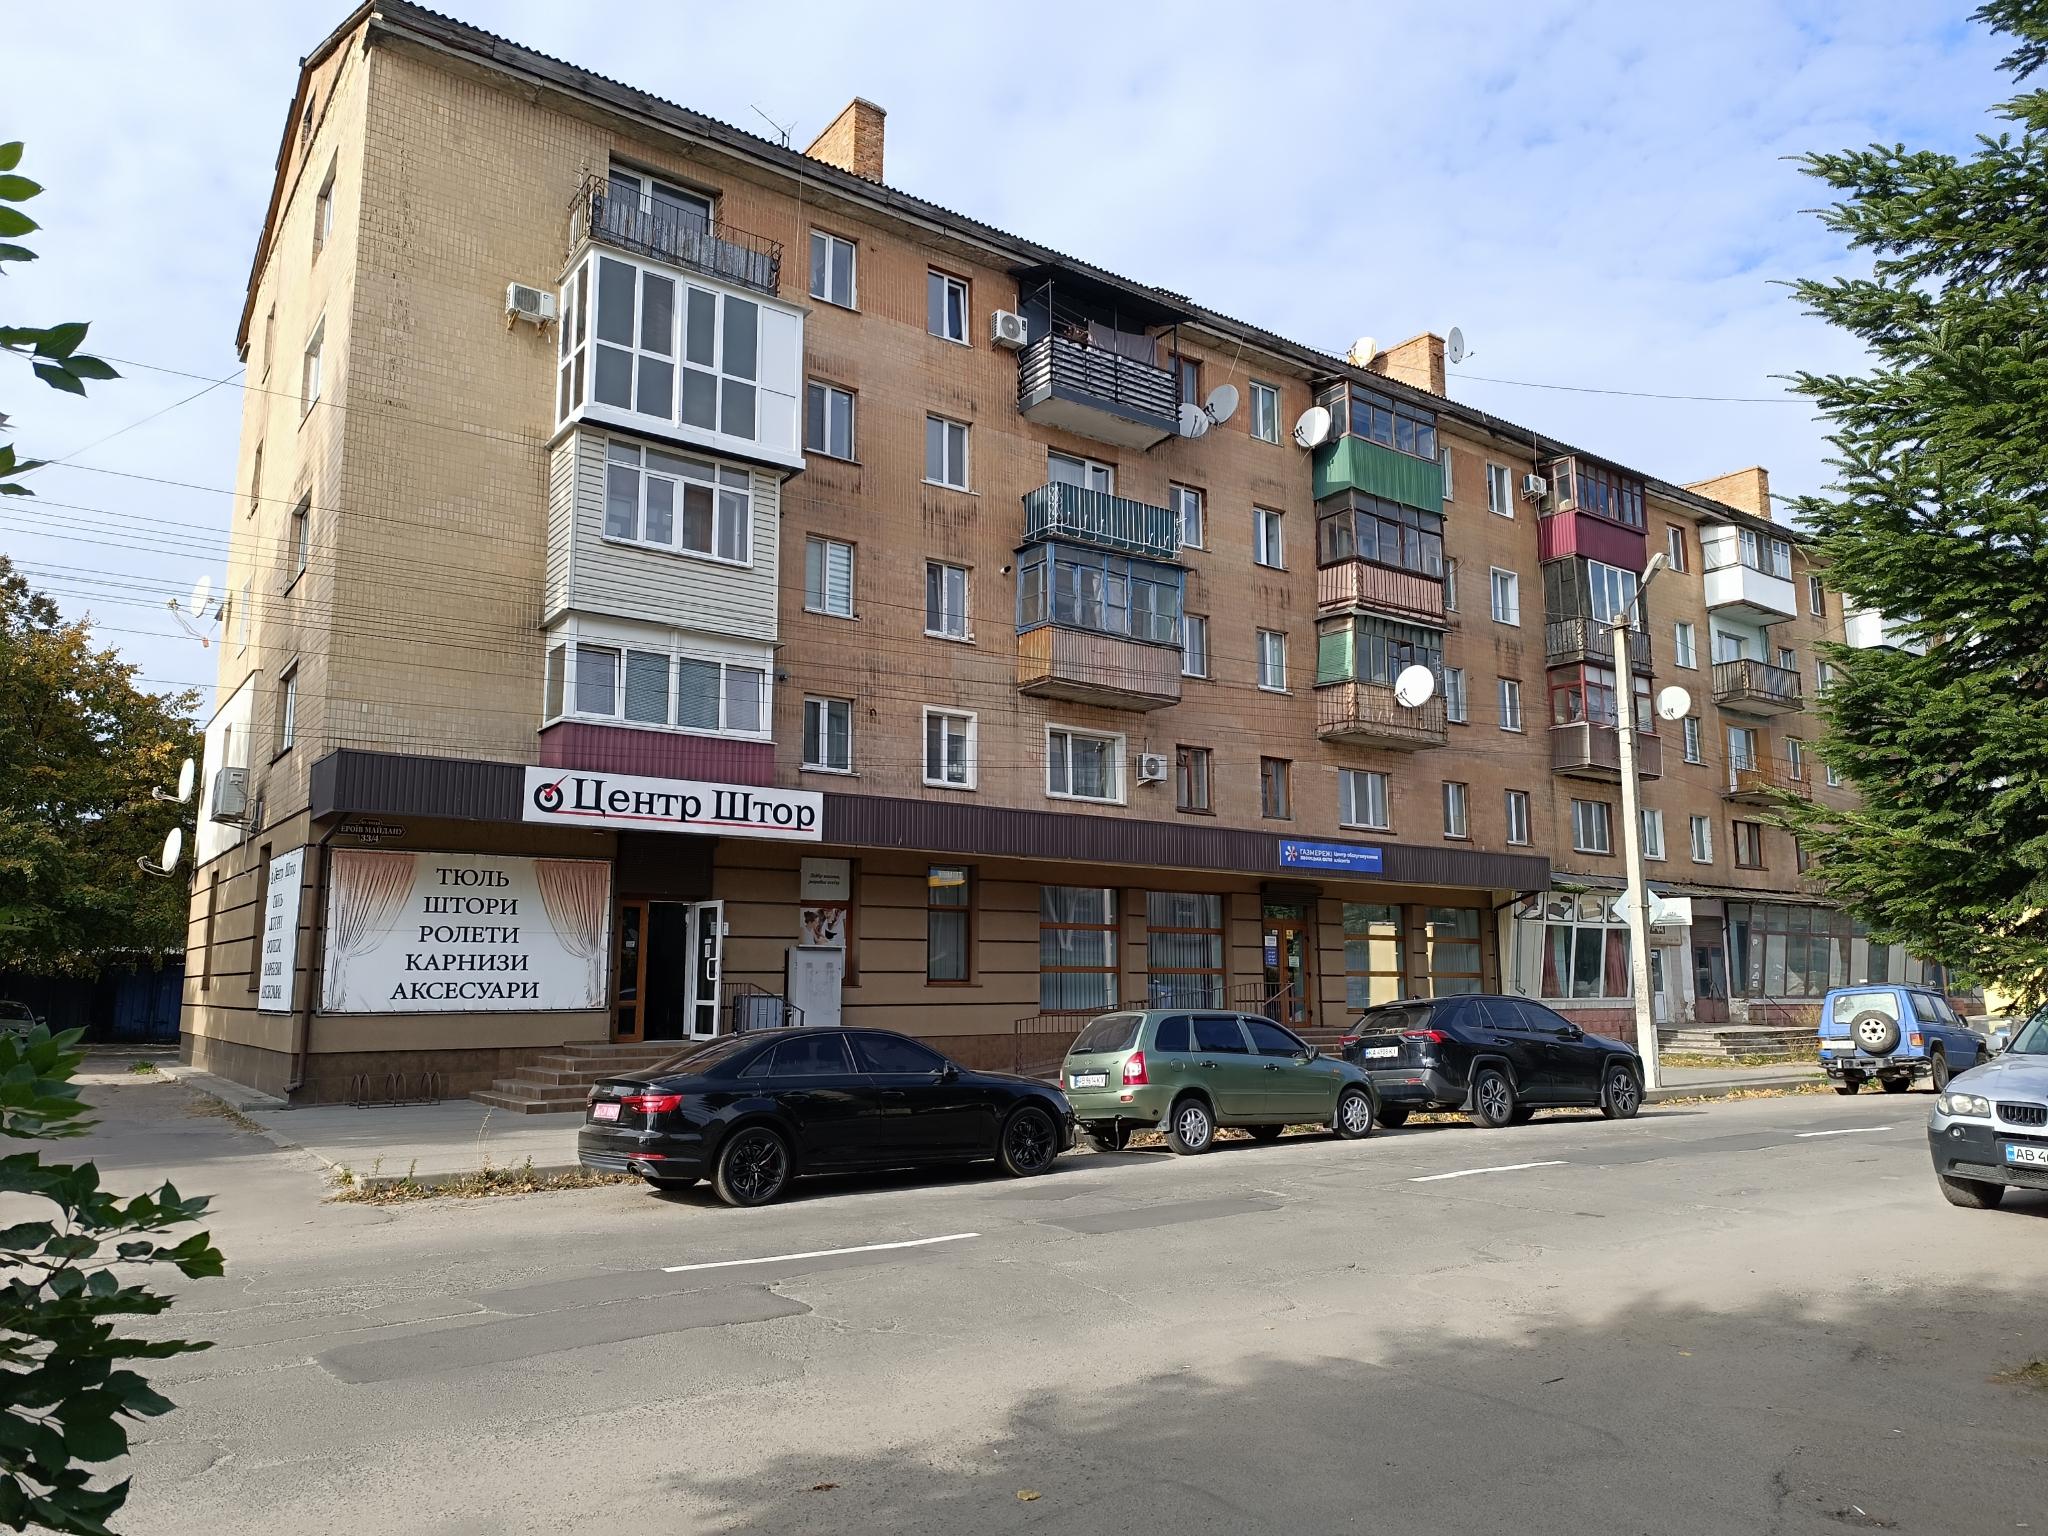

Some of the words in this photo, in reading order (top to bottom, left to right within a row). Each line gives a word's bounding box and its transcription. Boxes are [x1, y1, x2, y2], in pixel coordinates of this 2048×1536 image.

[571, 777, 701, 822] Центр
[711, 789, 815, 830] Штор
[360, 834, 379, 842] 33/4
[436, 868, 509, 887] ТЮЛЬ
[423, 896, 519, 915] ШТОРИ
[418, 925, 520, 944] РОЛЕТИ
[405, 953, 529, 971] КАРНИЗИ
[390, 981, 540, 1000] АКСЕСУАРИ
[2016, 1149, 2035, 1161] AB
[2039, 1151, 2048, 1163] 4
